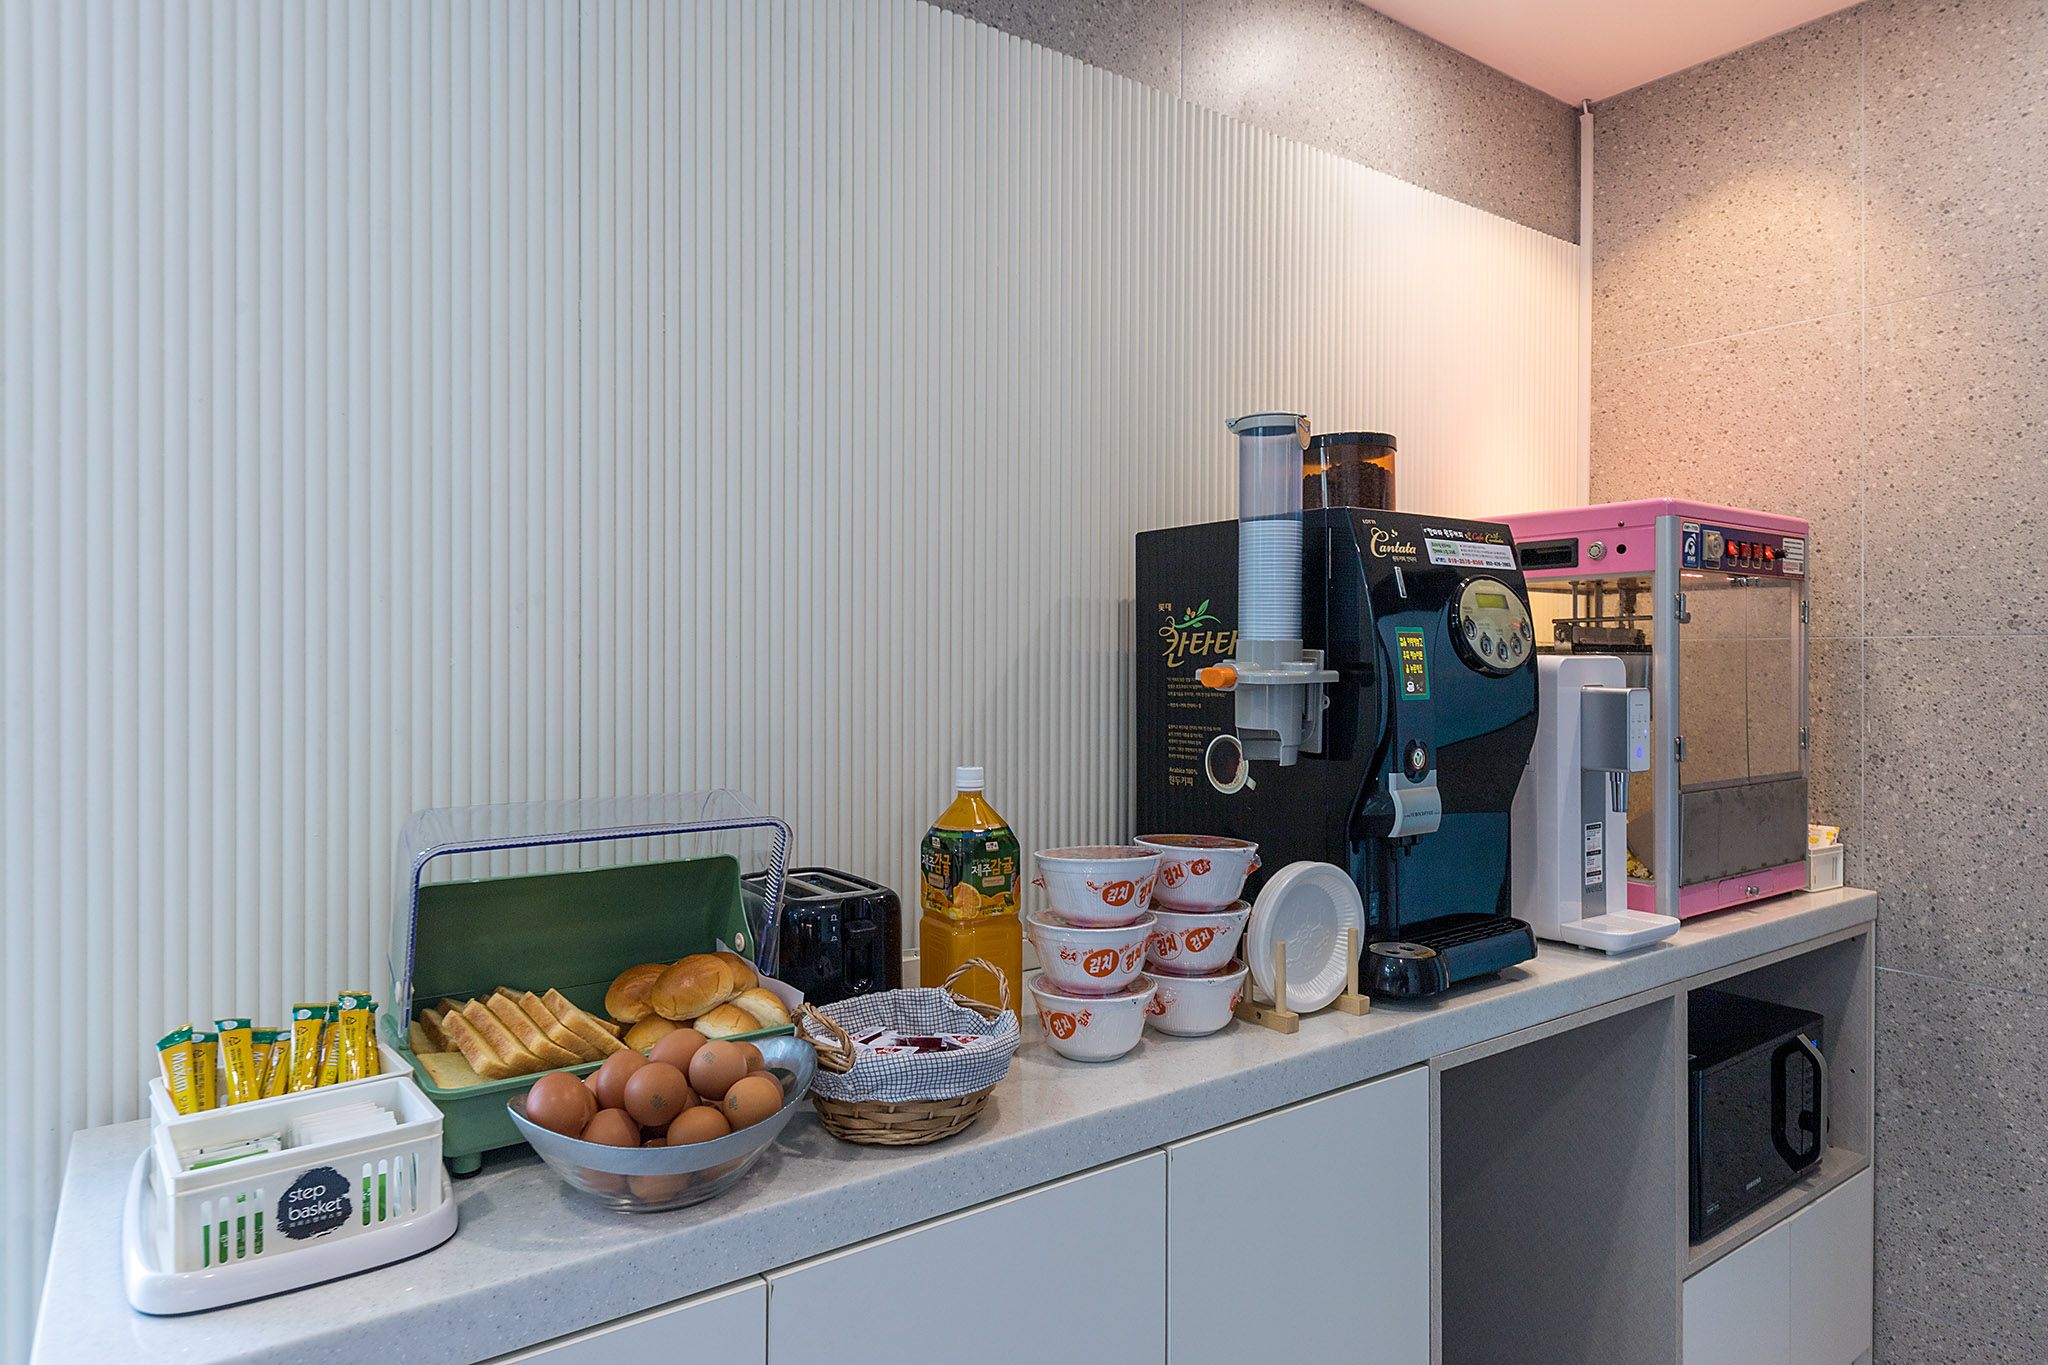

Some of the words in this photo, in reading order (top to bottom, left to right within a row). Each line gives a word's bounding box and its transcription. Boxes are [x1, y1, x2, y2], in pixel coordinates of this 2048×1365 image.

[1370, 527, 1417, 558] Cantata
[1158, 616, 1238, 668] 칸타타
[1169, 766, 1185, 775] Arabica
[1186, 767, 1198, 775] 100%
[1169, 775, 1193, 787] 원두커피
[921, 853, 951, 876] 제주감귤
[971, 857, 1013, 877] 제주감귤
[1163, 863, 1184, 886] 김치
[1107, 883, 1130, 902] 김치
[1139, 879, 1153, 906] 김치
[1585, 885, 1603, 894] wells
[1157, 934, 1178, 956] 김치
[1190, 928, 1211, 950] 김치
[1089, 951, 1113, 974] 김치
[1126, 943, 1143, 971] 김치
[1053, 1016, 1073, 1037] 김치
[1077, 1009, 1093, 1027] 김치
[171, 1052, 192, 1093] Maxim
[288, 1185, 326, 1203] step
[288, 1196, 342, 1221] basket
